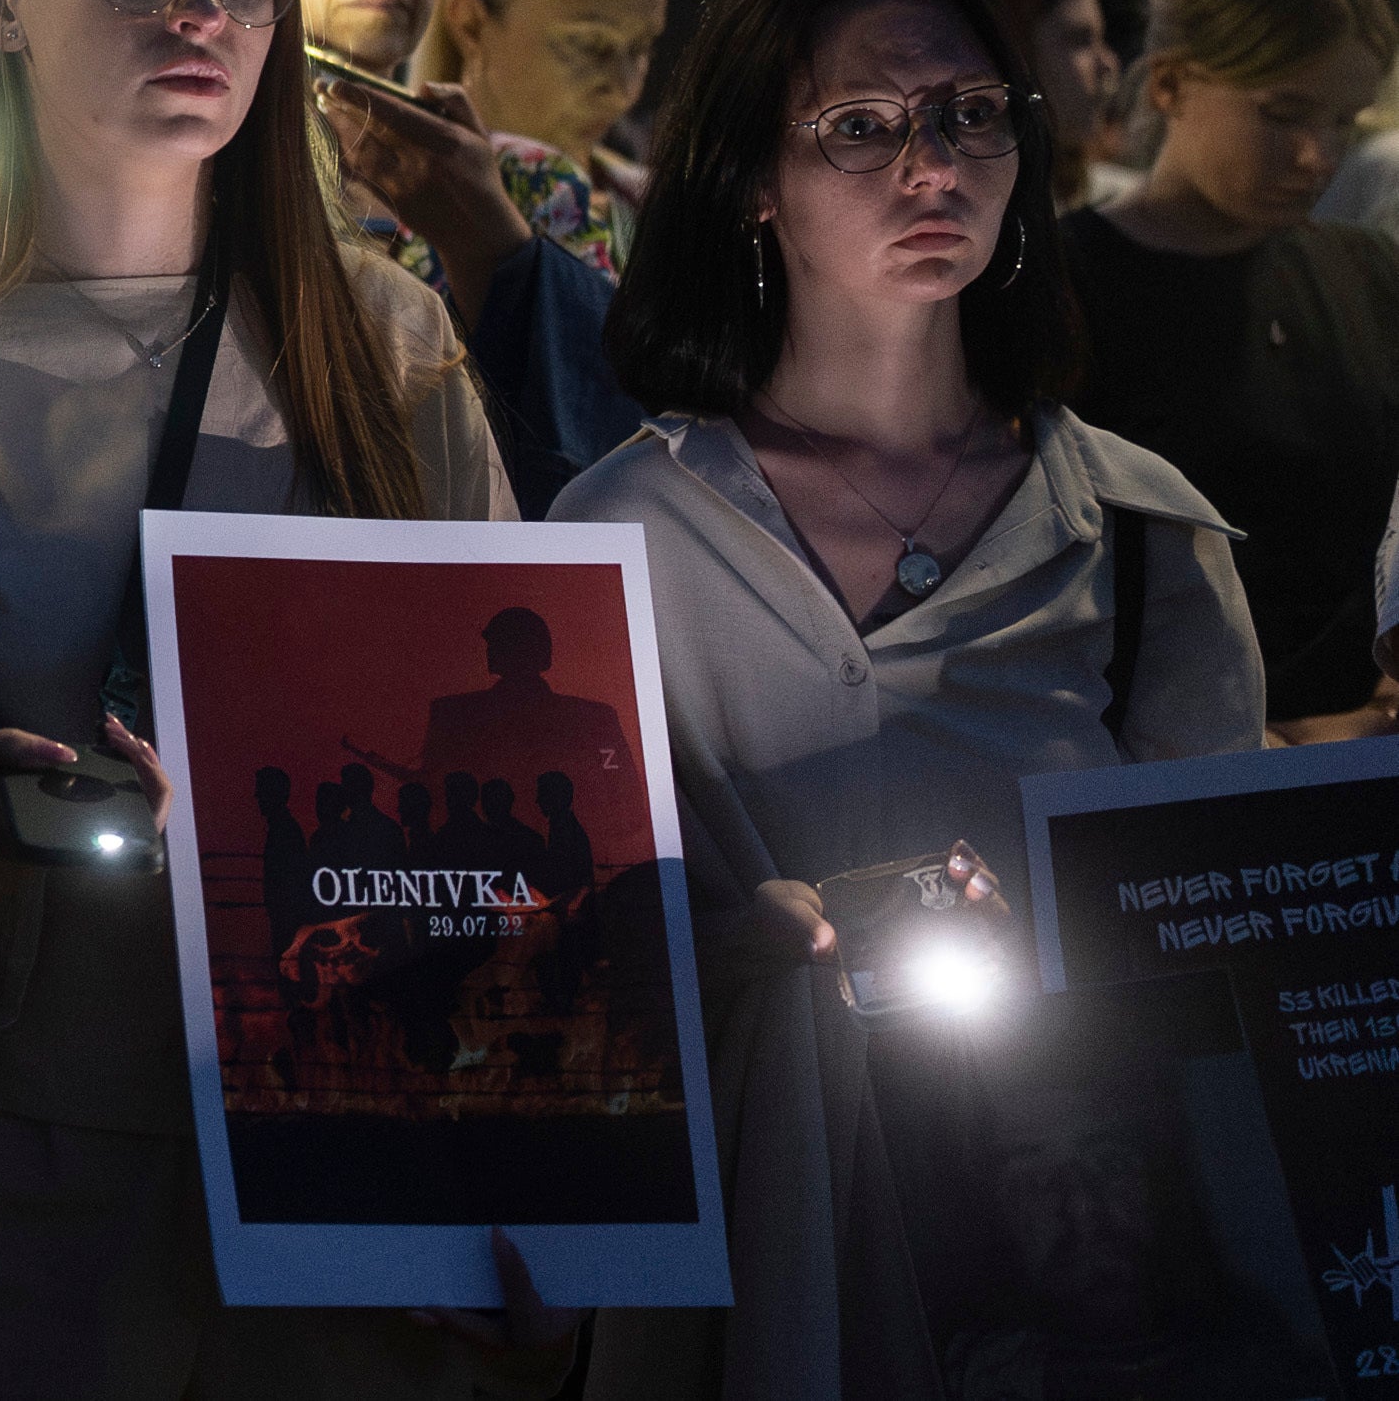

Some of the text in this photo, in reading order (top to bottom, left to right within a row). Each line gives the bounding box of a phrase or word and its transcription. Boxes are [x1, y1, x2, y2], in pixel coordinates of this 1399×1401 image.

[311, 866, 539, 909] OLENIVKA
[1117, 870, 1233, 912] NEVER
[1239, 852, 1380, 898] FORGET
[429, 915, 524, 938] 29.07.22
[1156, 910, 1275, 951] NEVER
[1288, 1014, 1399, 1045] THEN 13
